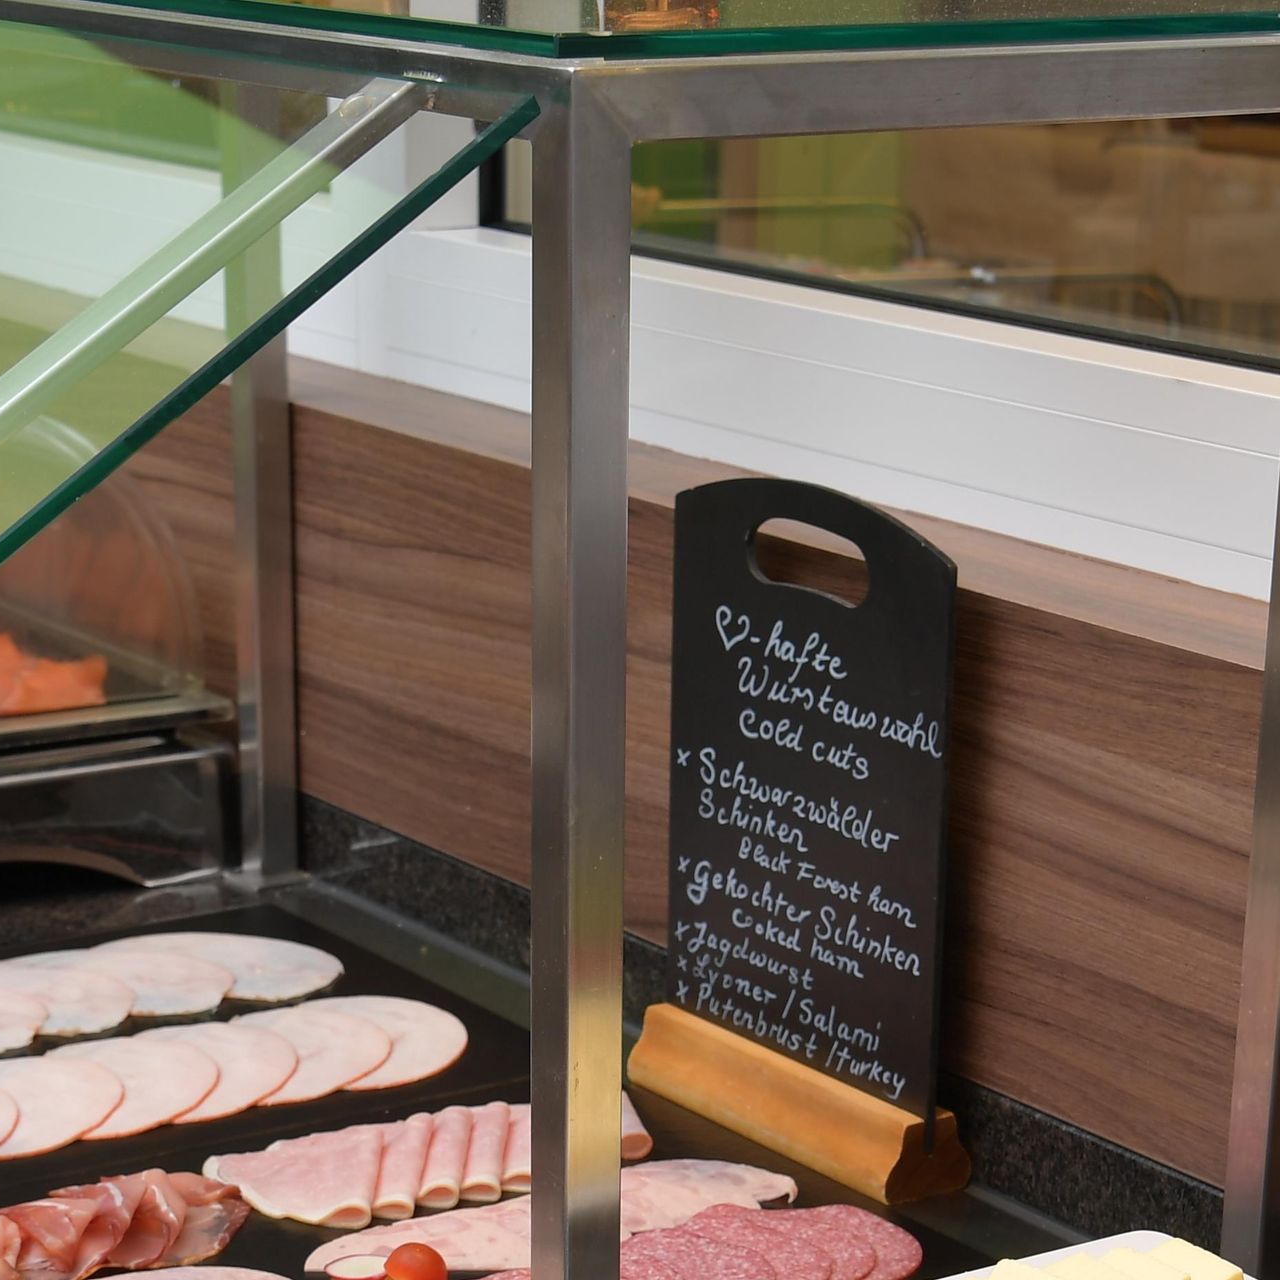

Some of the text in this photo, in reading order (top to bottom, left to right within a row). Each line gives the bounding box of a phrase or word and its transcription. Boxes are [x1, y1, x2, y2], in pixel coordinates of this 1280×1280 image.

[737, 656, 942, 758] Wurstauswahl
[739, 708, 870, 780] Cold cuts
[698, 788, 808, 853] Schinken
[699, 747, 900, 852] Schwarzwälder
[687, 860, 812, 924] Gekochter
[814, 905, 921, 976] Schinken
[738, 837, 917, 928] Black Forest ham
[687, 921, 814, 991] Jagdwurst
[810, 938, 865, 979] ham
